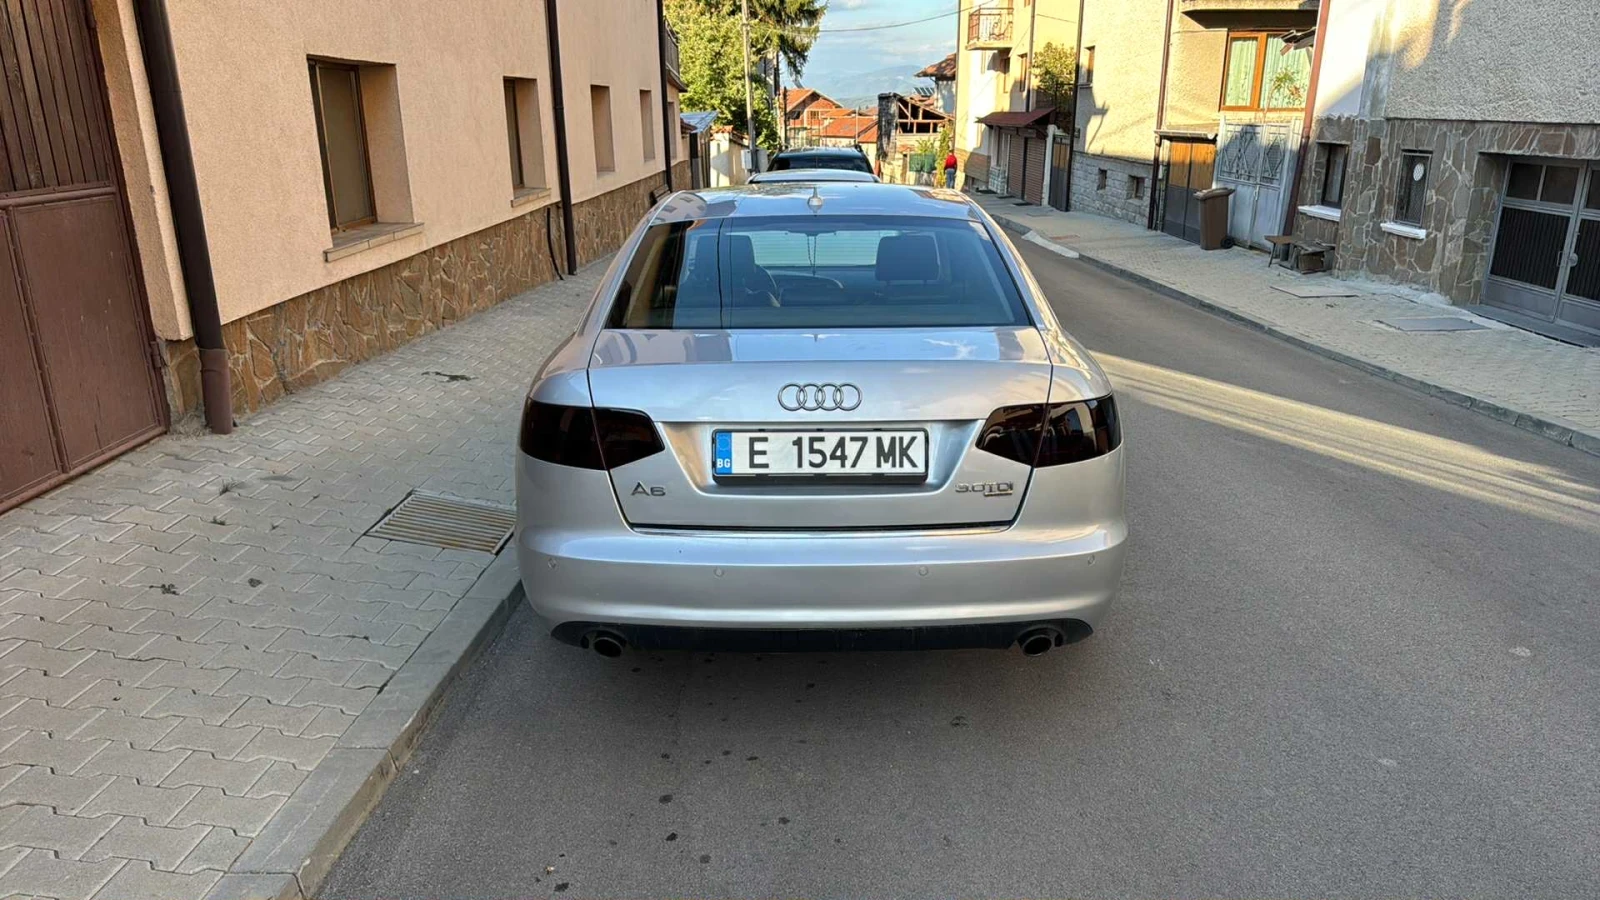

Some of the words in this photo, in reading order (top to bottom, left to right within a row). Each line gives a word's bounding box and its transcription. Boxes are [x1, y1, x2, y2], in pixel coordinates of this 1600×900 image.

[749, 436, 770, 469] E
[792, 436, 869, 469] 1547
[876, 436, 918, 469] MK
[716, 458, 731, 468] BG
[631, 481, 666, 496] A6
